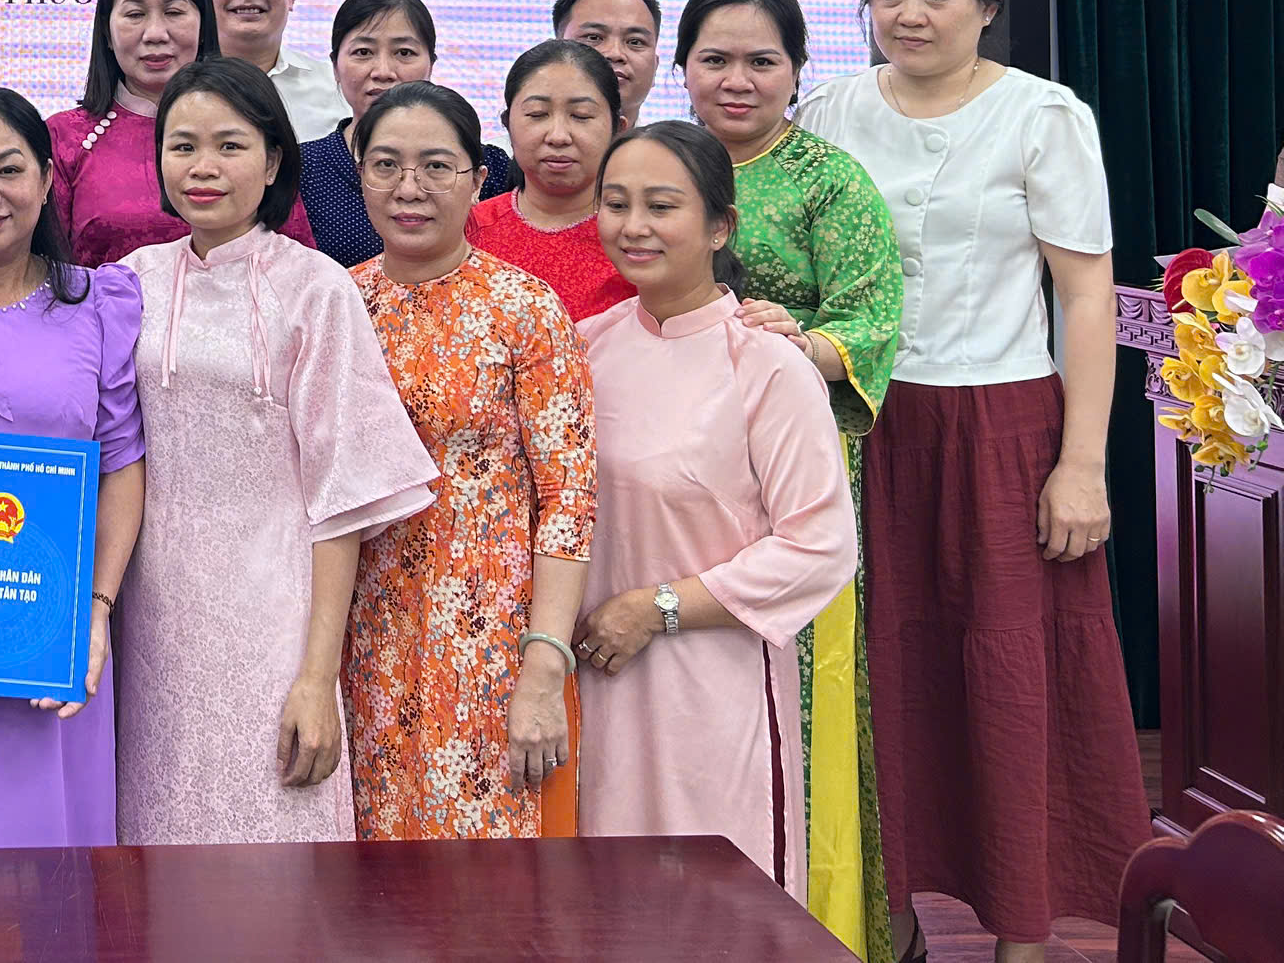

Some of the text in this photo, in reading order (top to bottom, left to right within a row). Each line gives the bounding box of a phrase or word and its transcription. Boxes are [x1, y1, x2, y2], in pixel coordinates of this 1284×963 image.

[57, 466, 76, 476] MINH
[21, 570, 42, 585] DÂN
[18, 588, 38, 603] TẠO
